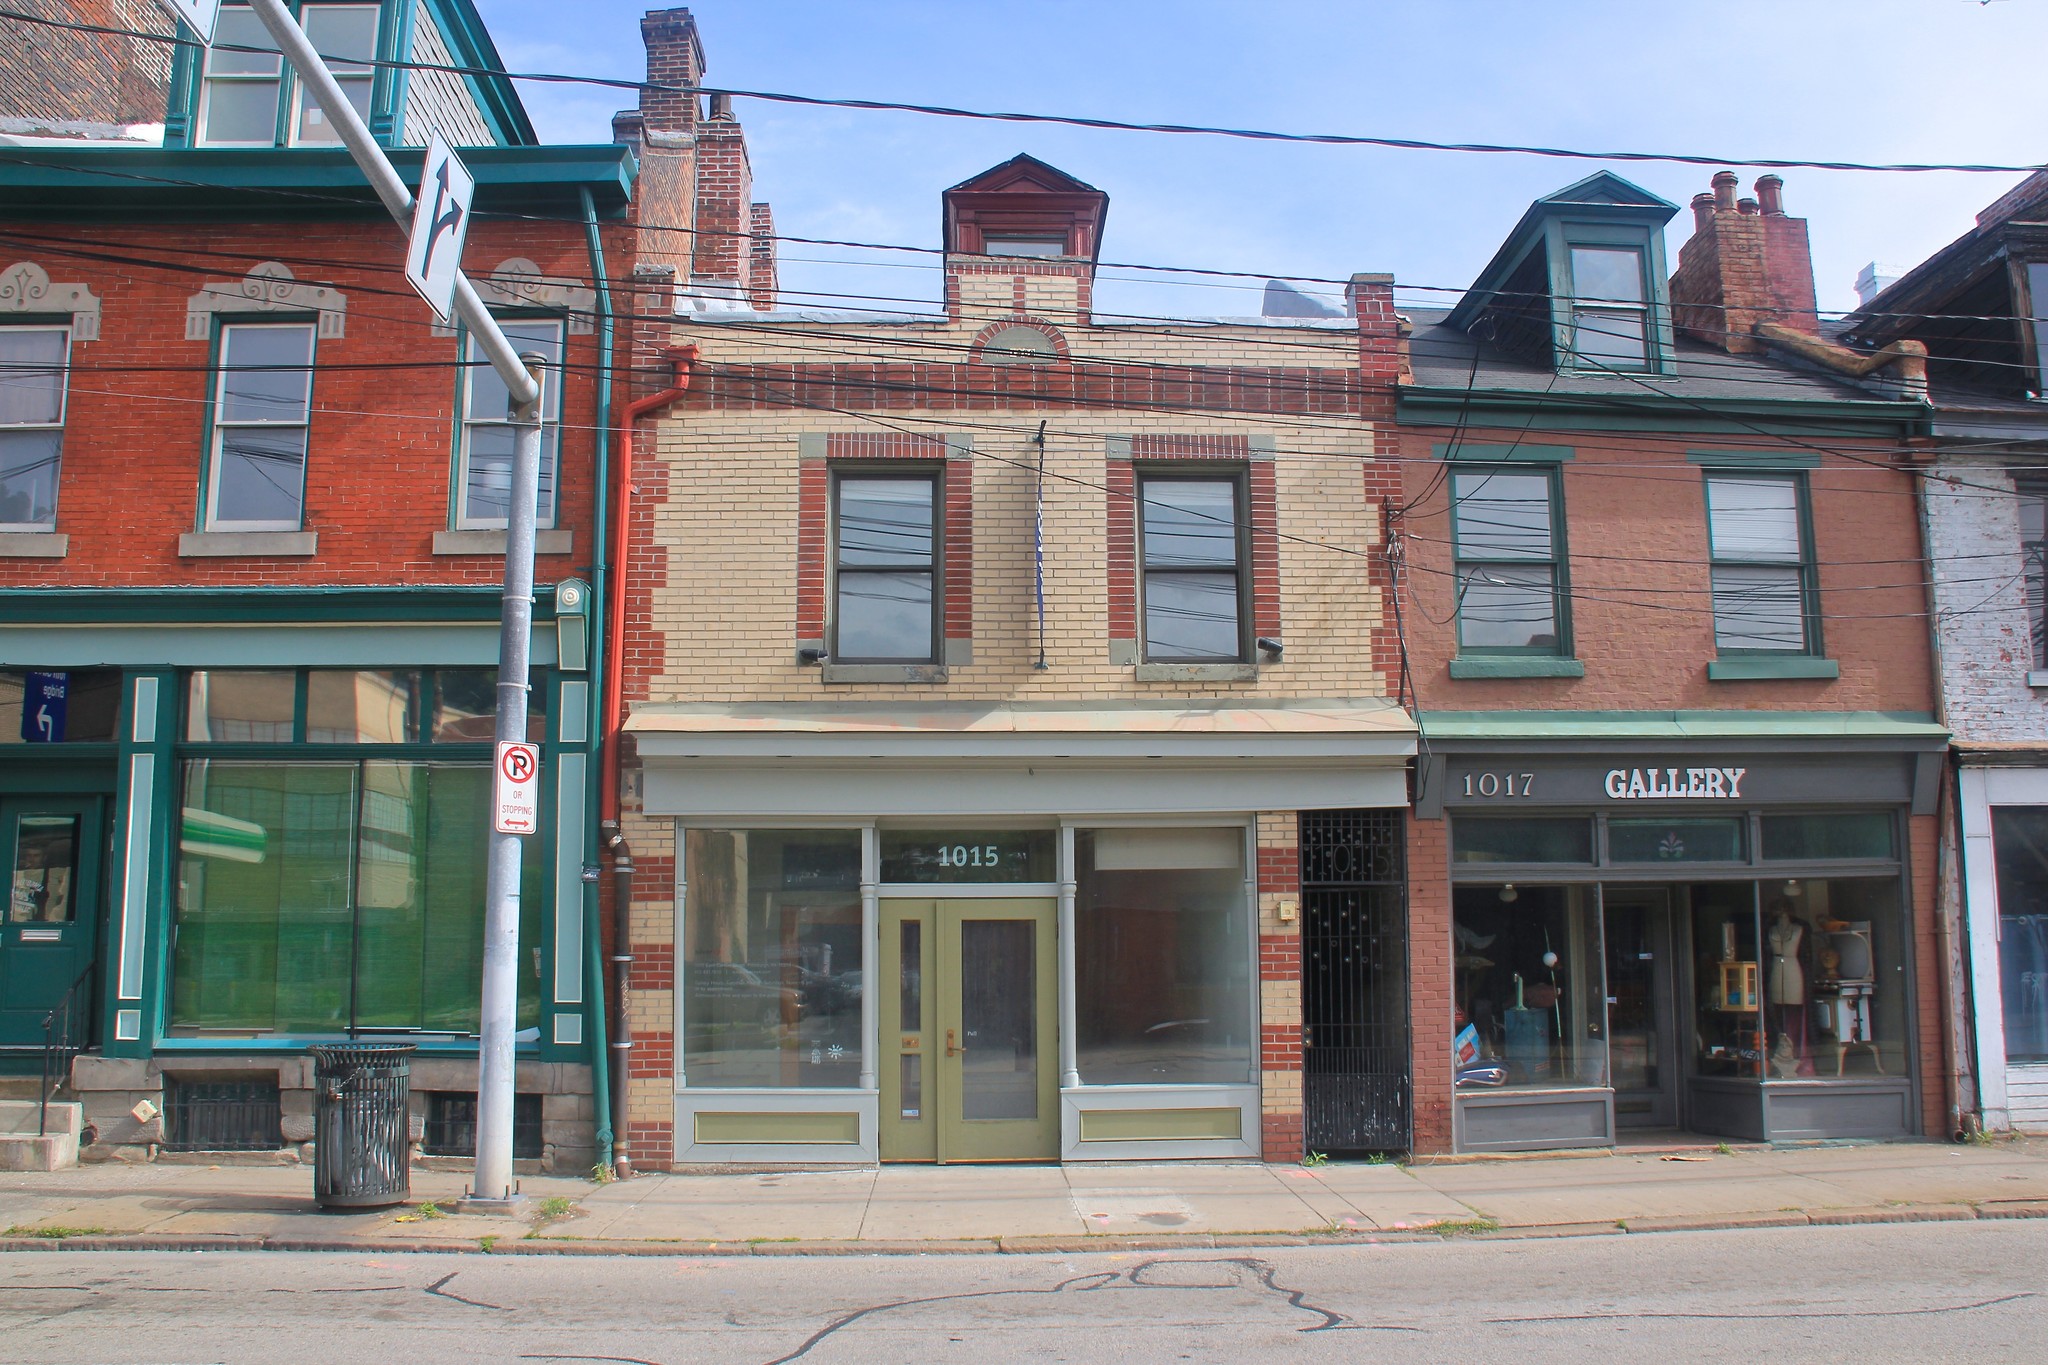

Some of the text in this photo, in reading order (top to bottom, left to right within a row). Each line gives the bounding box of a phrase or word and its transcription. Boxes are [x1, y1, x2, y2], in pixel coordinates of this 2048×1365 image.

[1463, 772, 1535, 797] 1017
[1603, 767, 1746, 799] GALLERY
[512, 790, 523, 800] OR
[501, 804, 533, 816] STOPPING
[937, 845, 999, 867] 1015
